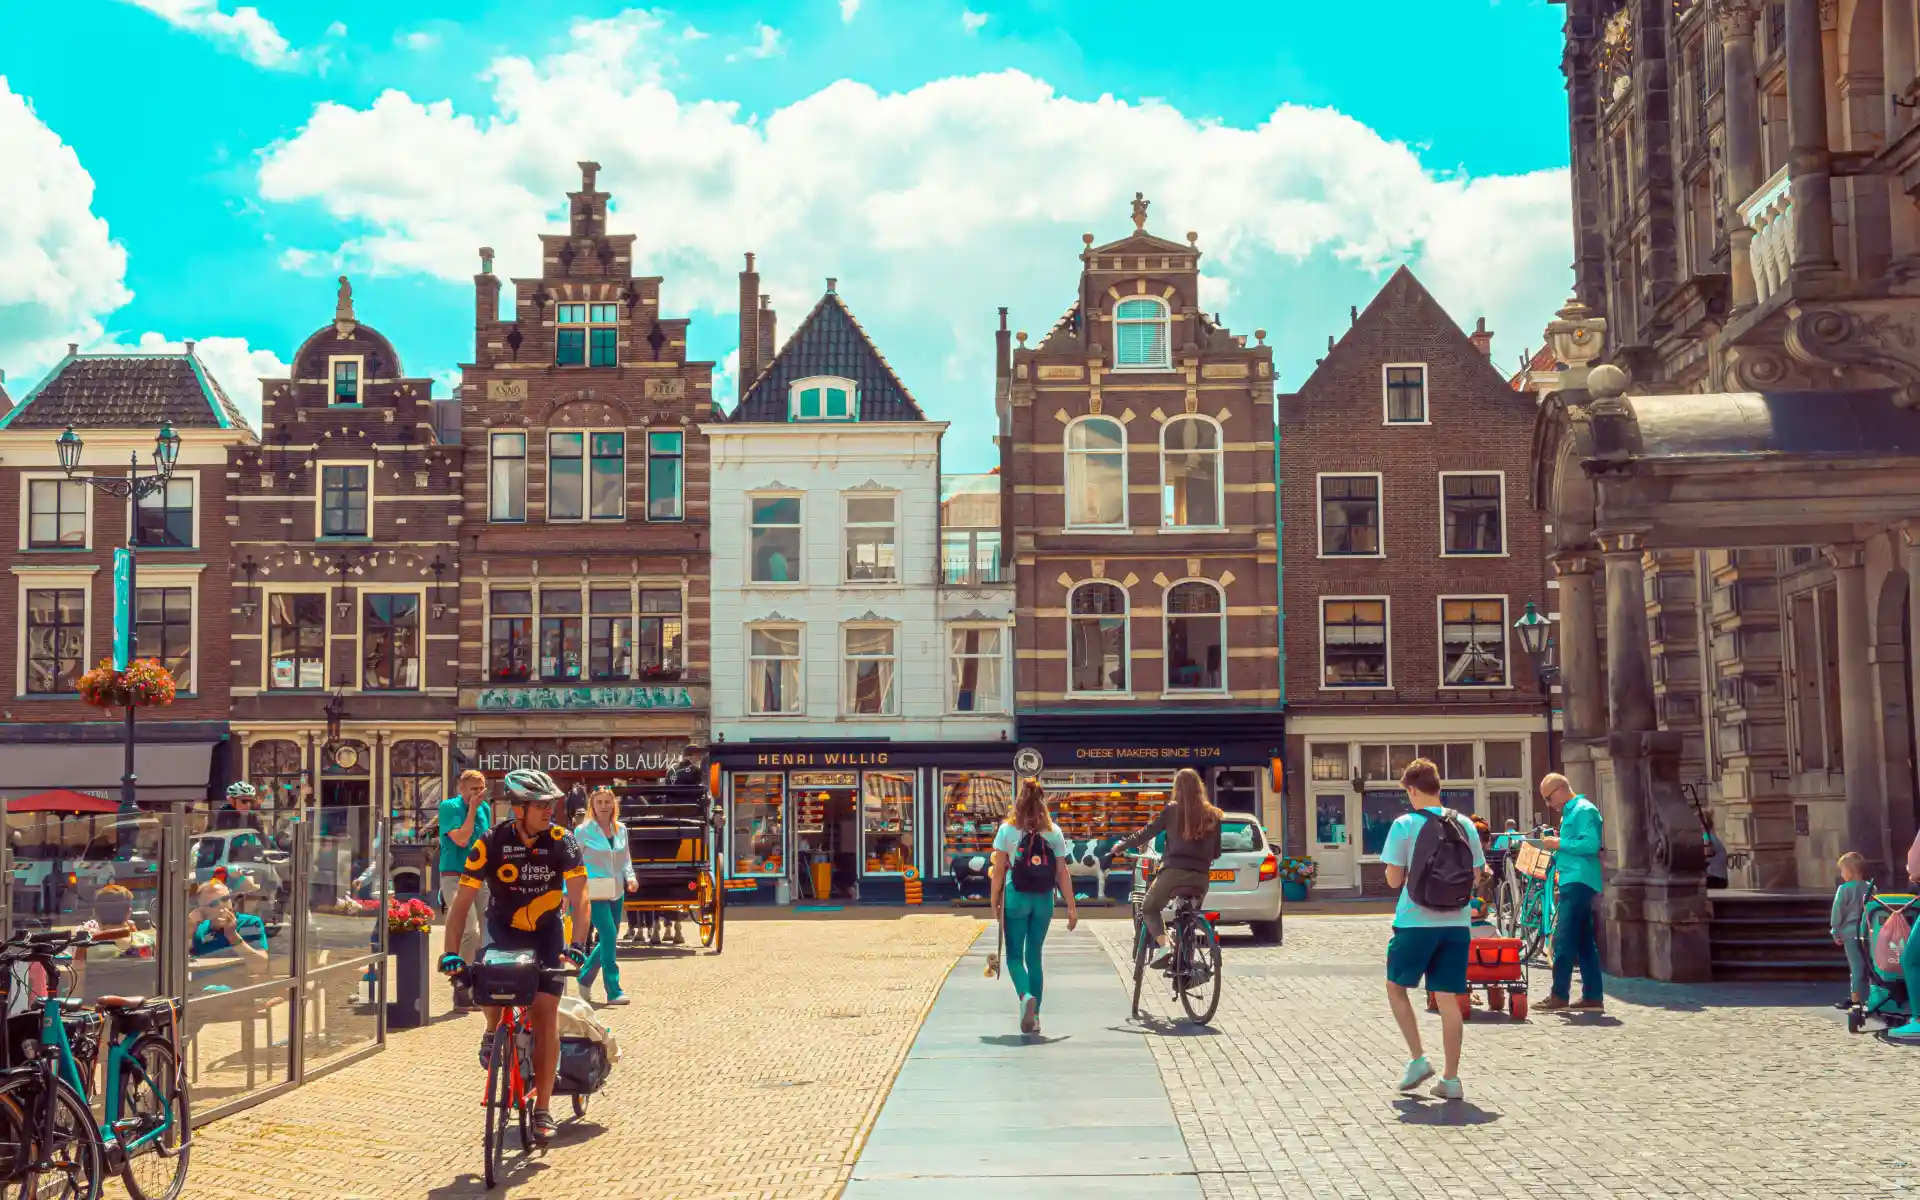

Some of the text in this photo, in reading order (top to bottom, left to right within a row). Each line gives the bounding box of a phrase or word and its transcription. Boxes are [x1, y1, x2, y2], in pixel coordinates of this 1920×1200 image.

[1076, 747, 1221, 758] CHEESE MAKERS SINCE 1974
[479, 753, 676, 770] HEINEN DELFTS BLAUW
[758, 753, 888, 765] HENRI WILLIG
